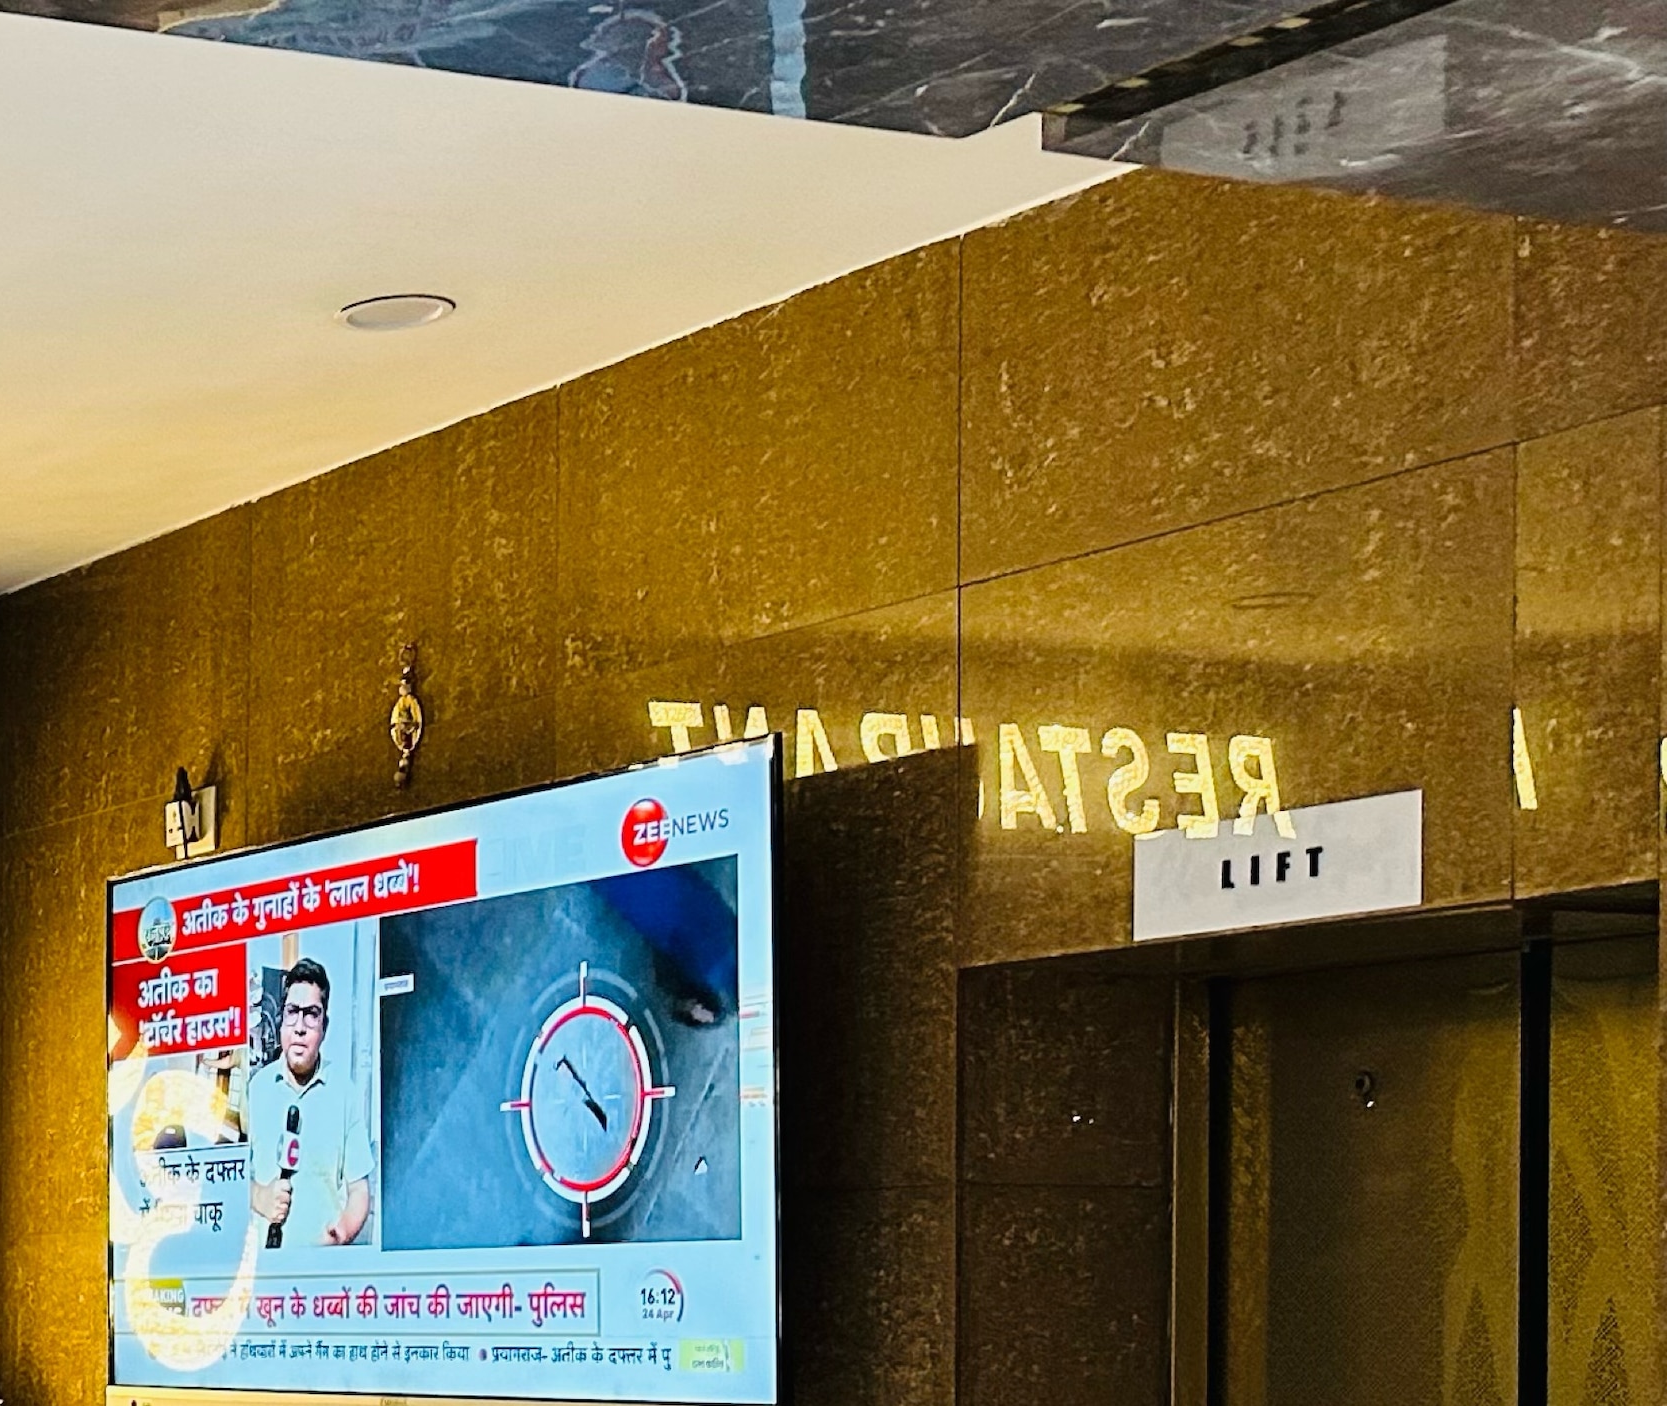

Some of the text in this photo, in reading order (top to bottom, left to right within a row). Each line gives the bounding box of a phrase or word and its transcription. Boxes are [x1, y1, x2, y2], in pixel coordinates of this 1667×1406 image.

[1221, 845, 1325, 890] LIFT
[182, 898, 228, 936] अतीक
[233, 893, 250, 925] के
[253, 881, 300, 930] गुनाहों
[302, 877, 321, 913] के
[137, 966, 218, 1009] अतीक का
[204, 1158, 245, 1184] दफ्तर
[255, 1295, 284, 1327] खून
[289, 1287, 307, 1319] के
[312, 1285, 351, 1320] धब्बों
[355, 1284, 378, 1320] की
[383, 1286, 421, 1320] जांच
[426, 1282, 451, 1321] की
[528, 1281, 586, 1328] पुलिस
[640, 1287, 676, 1306] 16:12
[442, 1340, 470, 1361] किया
[551, 1340, 587, 1364] अतीक
[591, 1341, 604, 1363] के
[608, 1347, 643, 1365] दफ्तर
[647, 1341, 658, 1364] में
